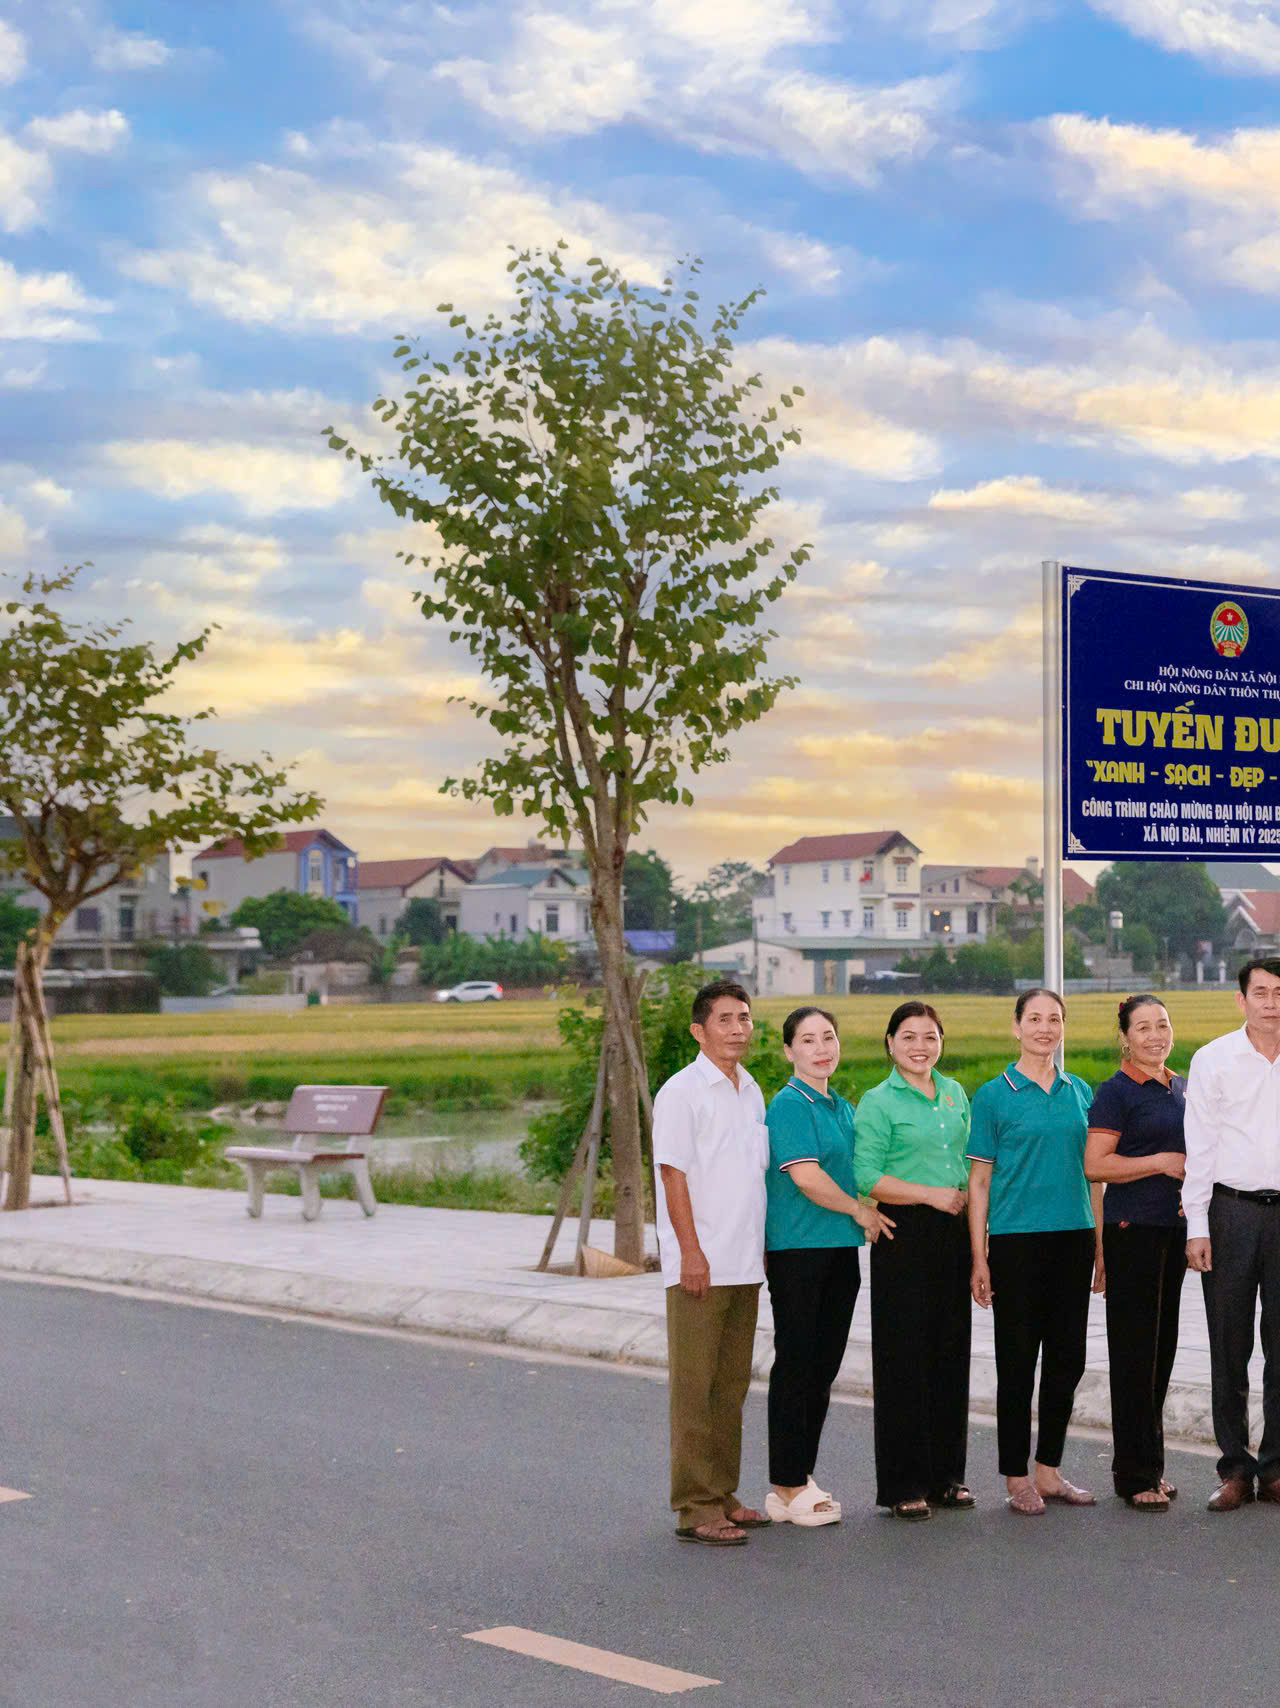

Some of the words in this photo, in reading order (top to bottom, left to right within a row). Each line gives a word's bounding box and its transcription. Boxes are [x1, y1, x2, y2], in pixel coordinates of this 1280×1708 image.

[1159, 664, 1178, 677] HỘI
[1182, 666, 1212, 680] NÔNG
[1215, 668, 1238, 681] DÂN
[1240, 670, 1256, 682] XÃ
[1258, 671, 1277, 685] NỘI
[1124, 680, 1144, 690] CHI
[1146, 679, 1166, 694] HỘI
[1169, 681, 1200, 694] NÔNG
[1203, 683, 1227, 696] DÂN
[1229, 685, 1259, 699] THÔN
[1096, 700, 1224, 751] TUYẾN
[1164, 763, 1211, 790] SẠCH
[1230, 766, 1264, 792] ĐẸP
[1081, 799, 1113, 817] CÔNG
[1115, 798, 1147, 818] TRÌNH
[1150, 800, 1178, 819] CHÀO
[1181, 801, 1213, 820] MỪNG
[1215, 804, 1232, 824] ĐẠI
[1235, 802, 1253, 824] HỘI
[1255, 805, 1273, 824] ĐẠI
[1143, 823, 1158, 842] XÃ
[1160, 823, 1180, 846] NỘI
[1182, 823, 1204, 844] BÀI,
[1206, 824, 1240, 847] NHIỆM
[1242, 824, 1256, 844] KỲ
